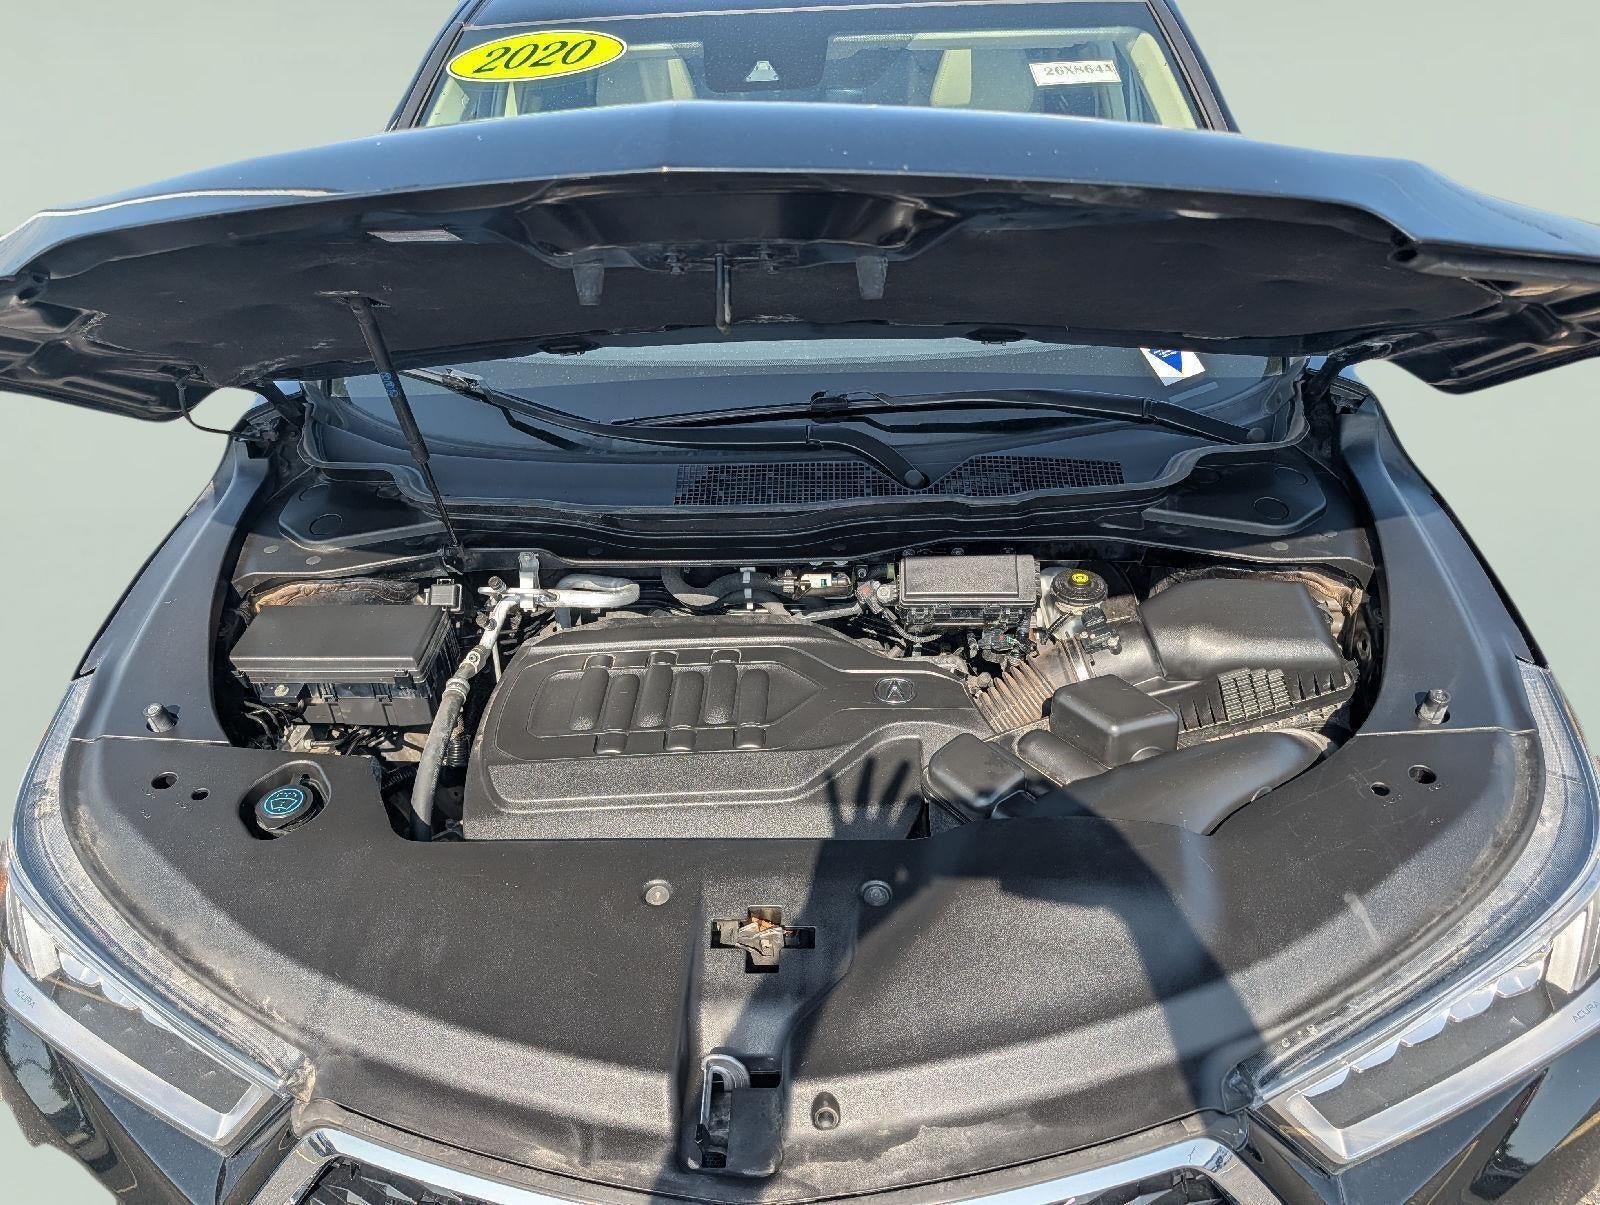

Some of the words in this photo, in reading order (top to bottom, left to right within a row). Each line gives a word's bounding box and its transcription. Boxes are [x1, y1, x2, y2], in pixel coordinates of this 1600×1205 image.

[473, 39, 597, 74] 2020
[15, 987, 36, 1008] ACURA
[1572, 1000, 1600, 1023] ACURA
